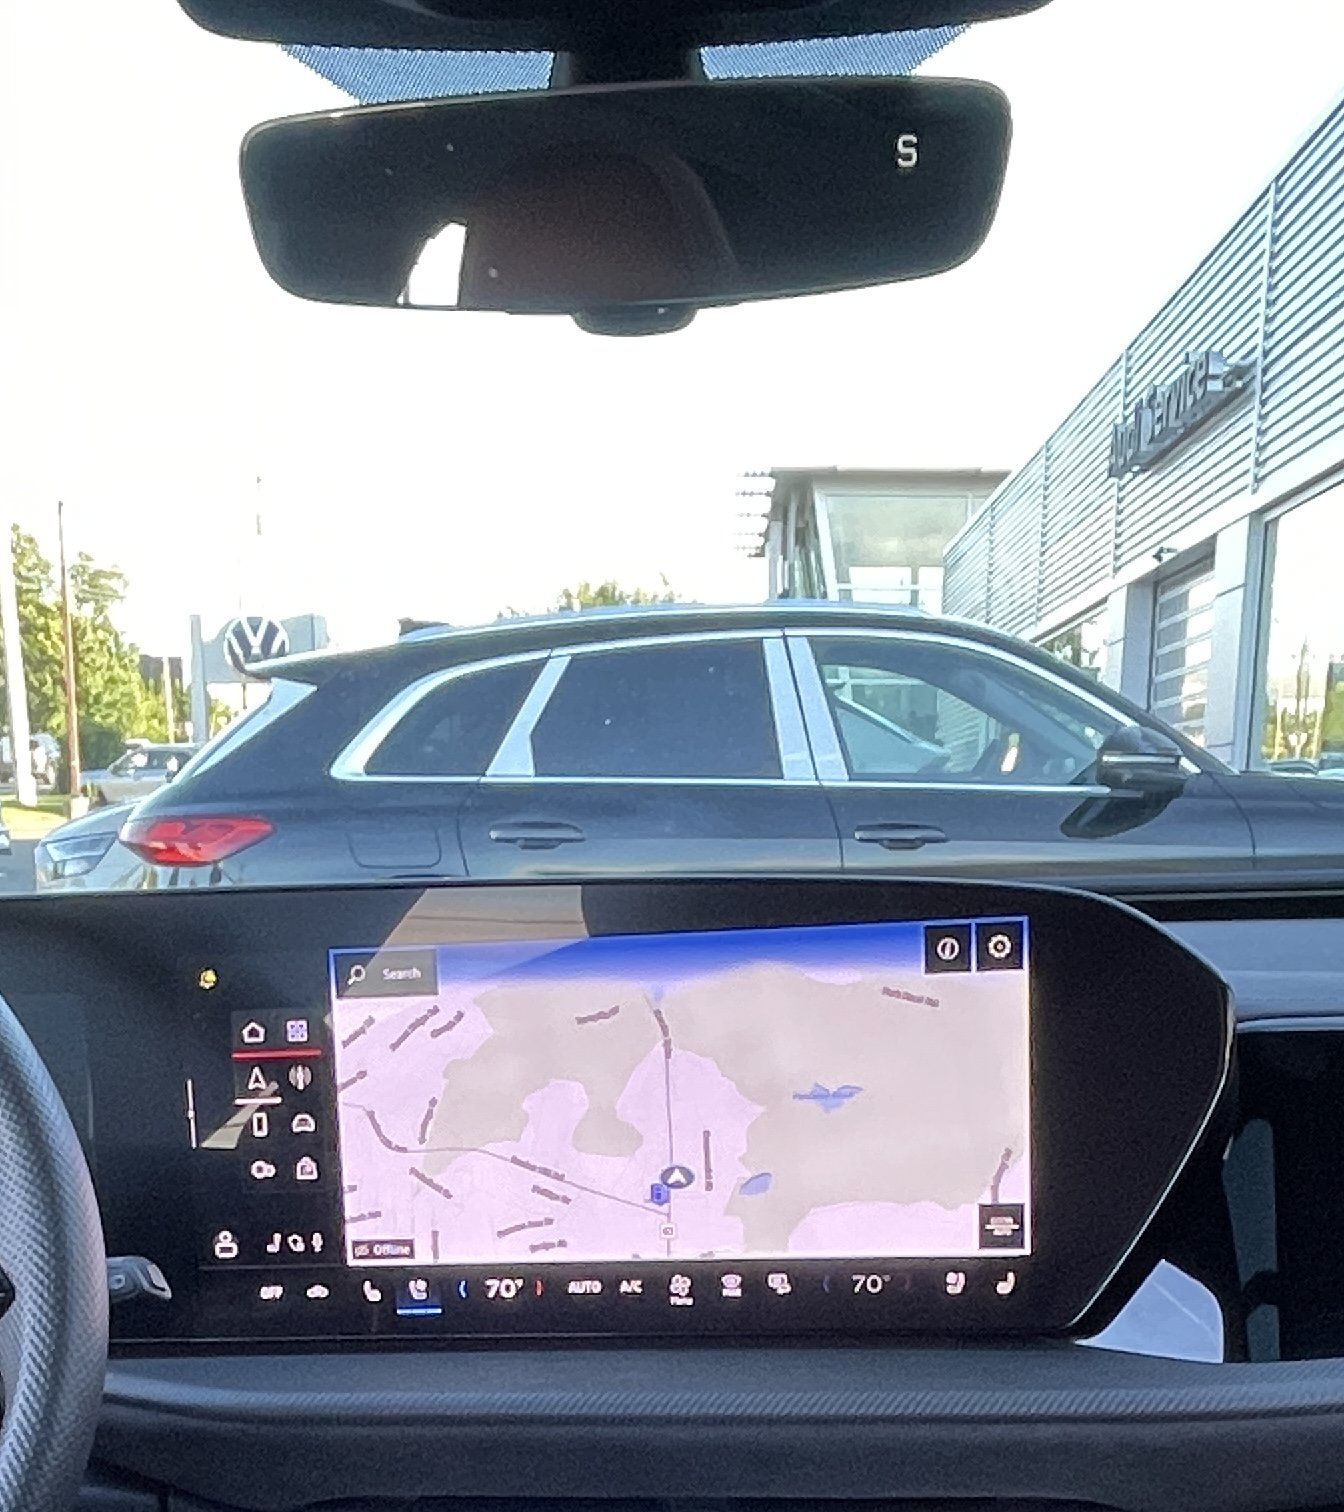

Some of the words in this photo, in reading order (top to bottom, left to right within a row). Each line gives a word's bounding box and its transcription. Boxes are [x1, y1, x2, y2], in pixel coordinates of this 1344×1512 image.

[896, 133, 919, 169] S
[382, 966, 422, 980] Search
[568, 1280, 603, 1294] AUTO
[619, 1279, 644, 1294] A/C
